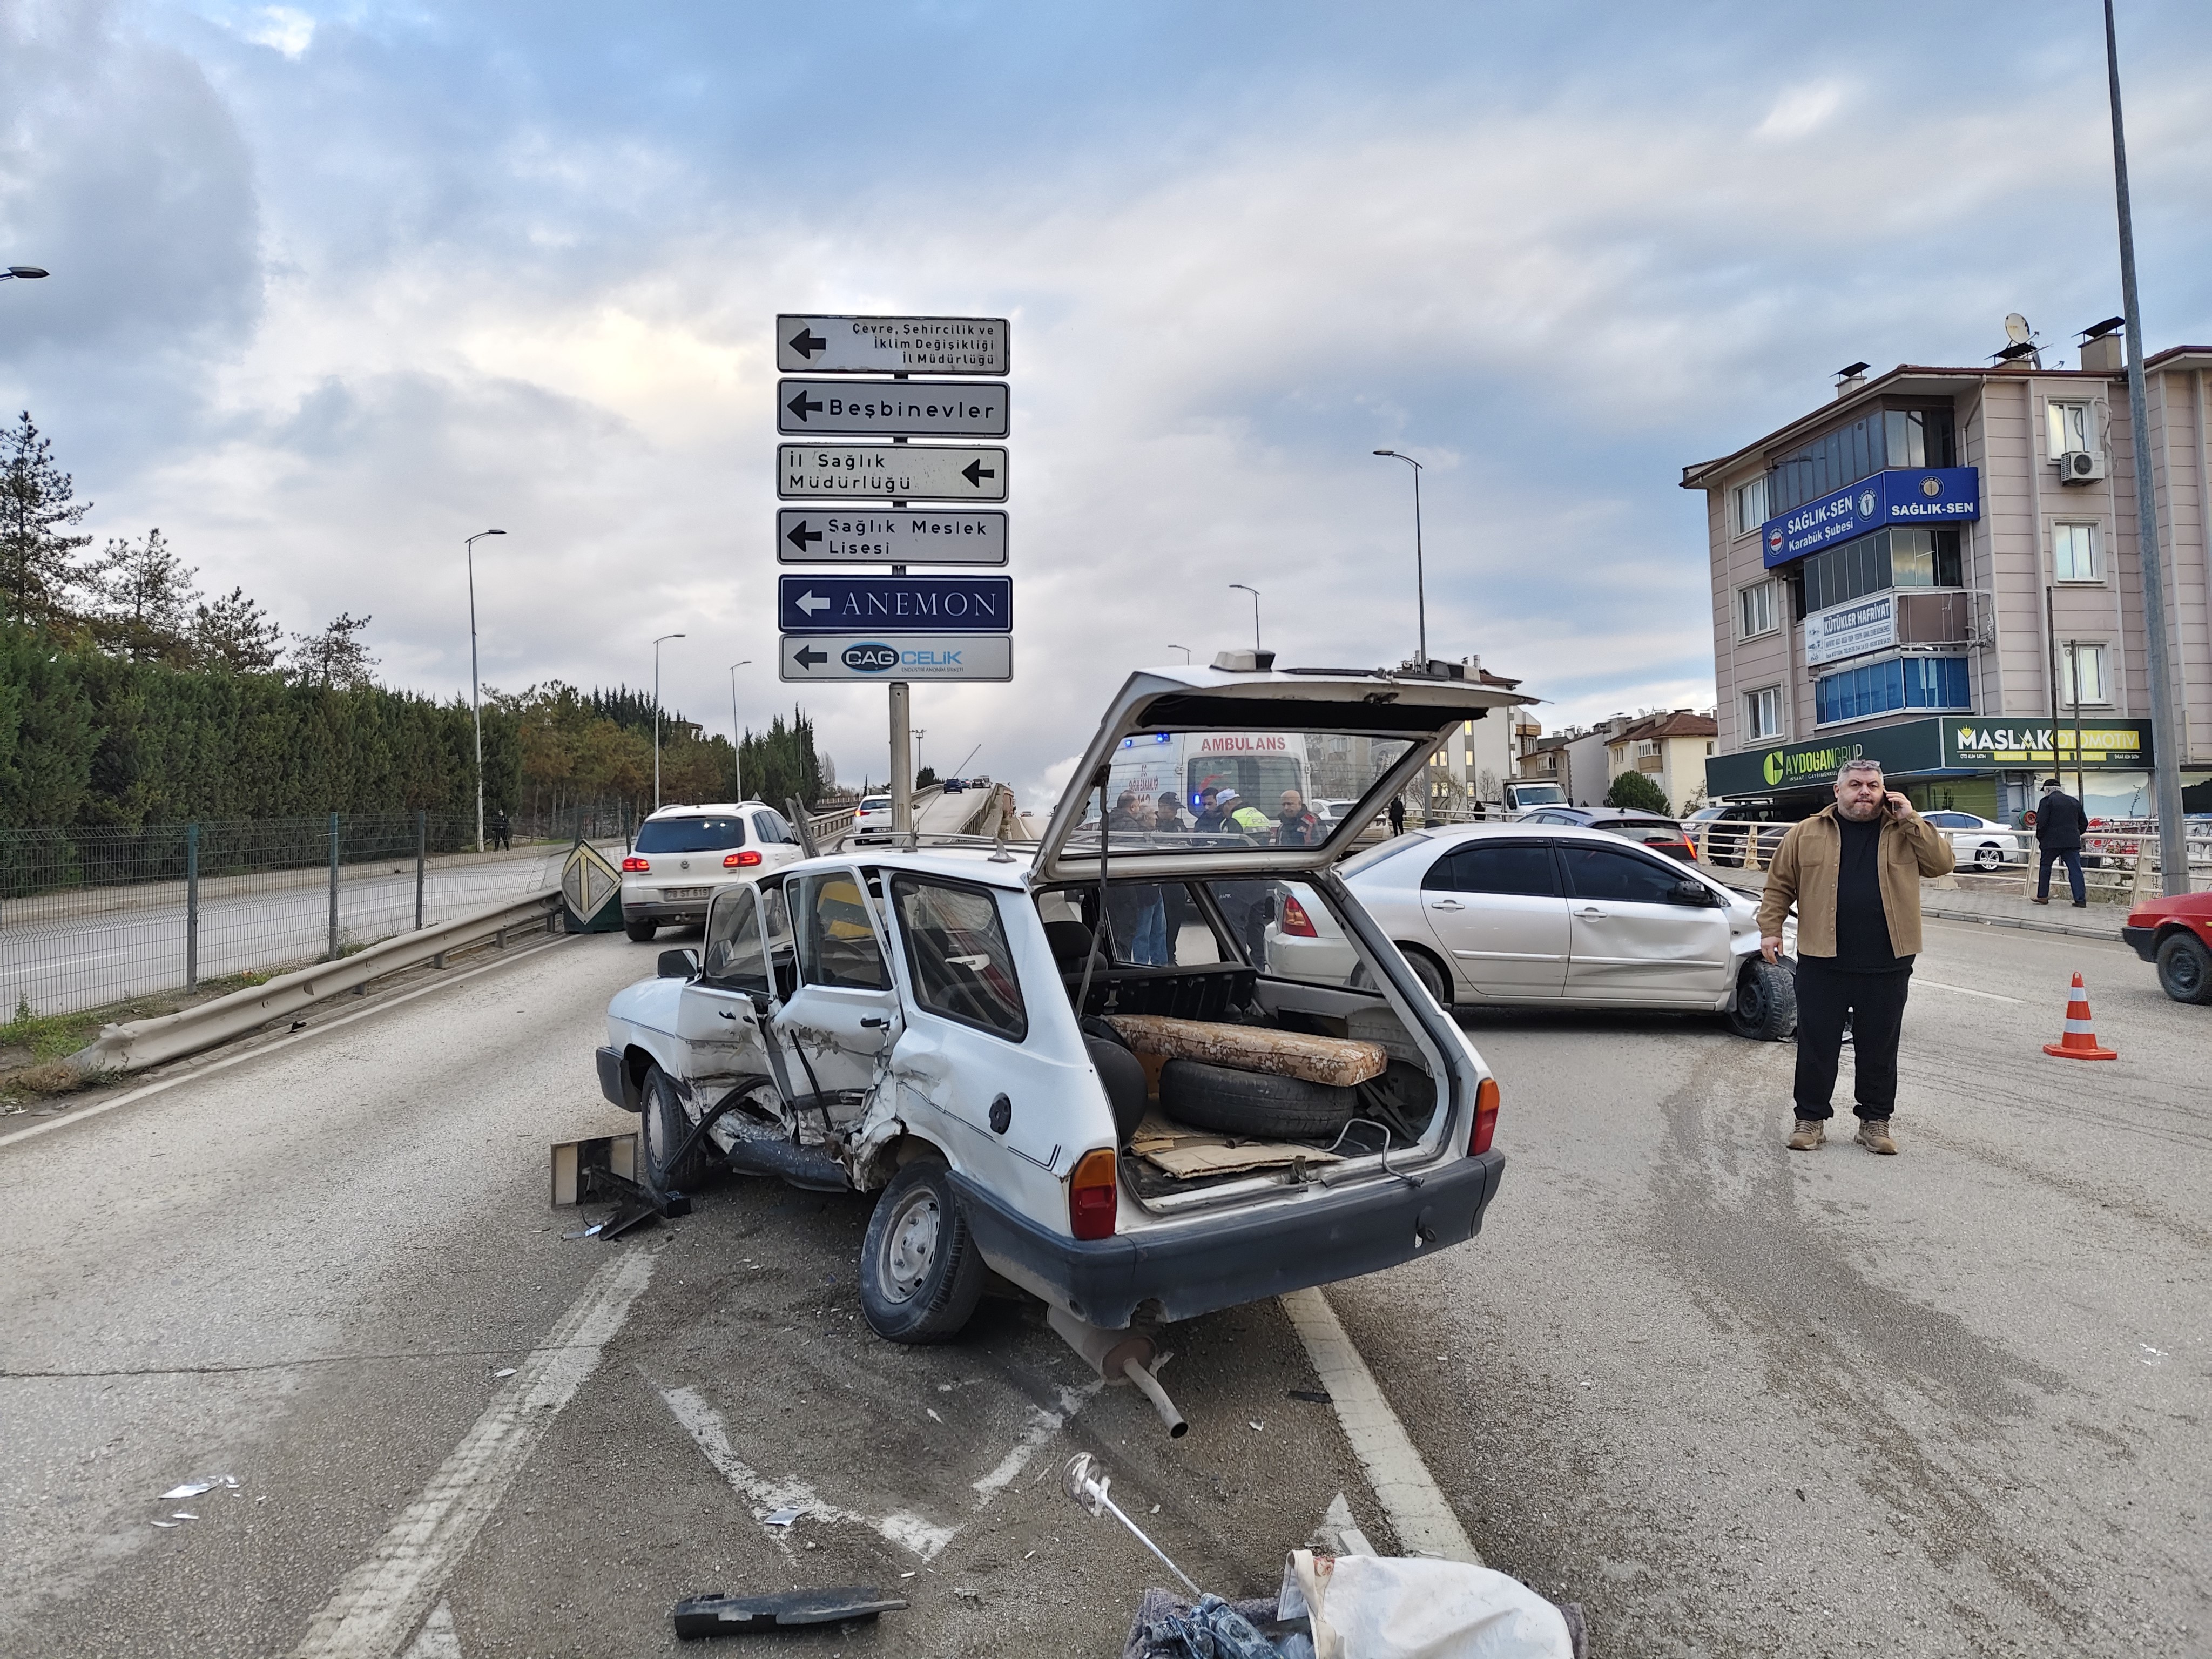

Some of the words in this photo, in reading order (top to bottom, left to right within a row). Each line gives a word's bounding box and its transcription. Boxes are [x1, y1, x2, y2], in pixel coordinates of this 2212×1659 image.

[853, 323, 899, 335] Çevre,
[903, 323, 975, 335] Şehircilik
[979, 326, 994, 335] ve
[874, 336, 911, 349] İklim
[916, 338, 994, 351] Değişikliği
[902, 350, 913, 364] İl
[918, 353, 994, 365] Müdürlüğü
[830, 399, 995, 419] Beşbinevler
[790, 451, 802, 468] İl
[818, 453, 885, 471] Sağlık
[790, 475, 911, 493] Müdürlüğü
[1787, 495, 1853, 535] SAĞLIK-SEN
[1891, 502, 1974, 516] SAĞLIK-SEN
[828, 519, 895, 536] Sağlık
[912, 520, 987, 536] Meslek
[1789, 531, 1823, 552] Karabük
[1825, 516, 1854, 541] Şubesi
[830, 540, 891, 555] Lisesi
[841, 592, 997, 617] ANEMON
[1824, 612, 1857, 634] KÜTÜKLER
[1857, 602, 1890, 624] HAFRİYAT
[1201, 737, 1286, 751] AMBULANS
[1957, 729, 2053, 750] MASLAK
